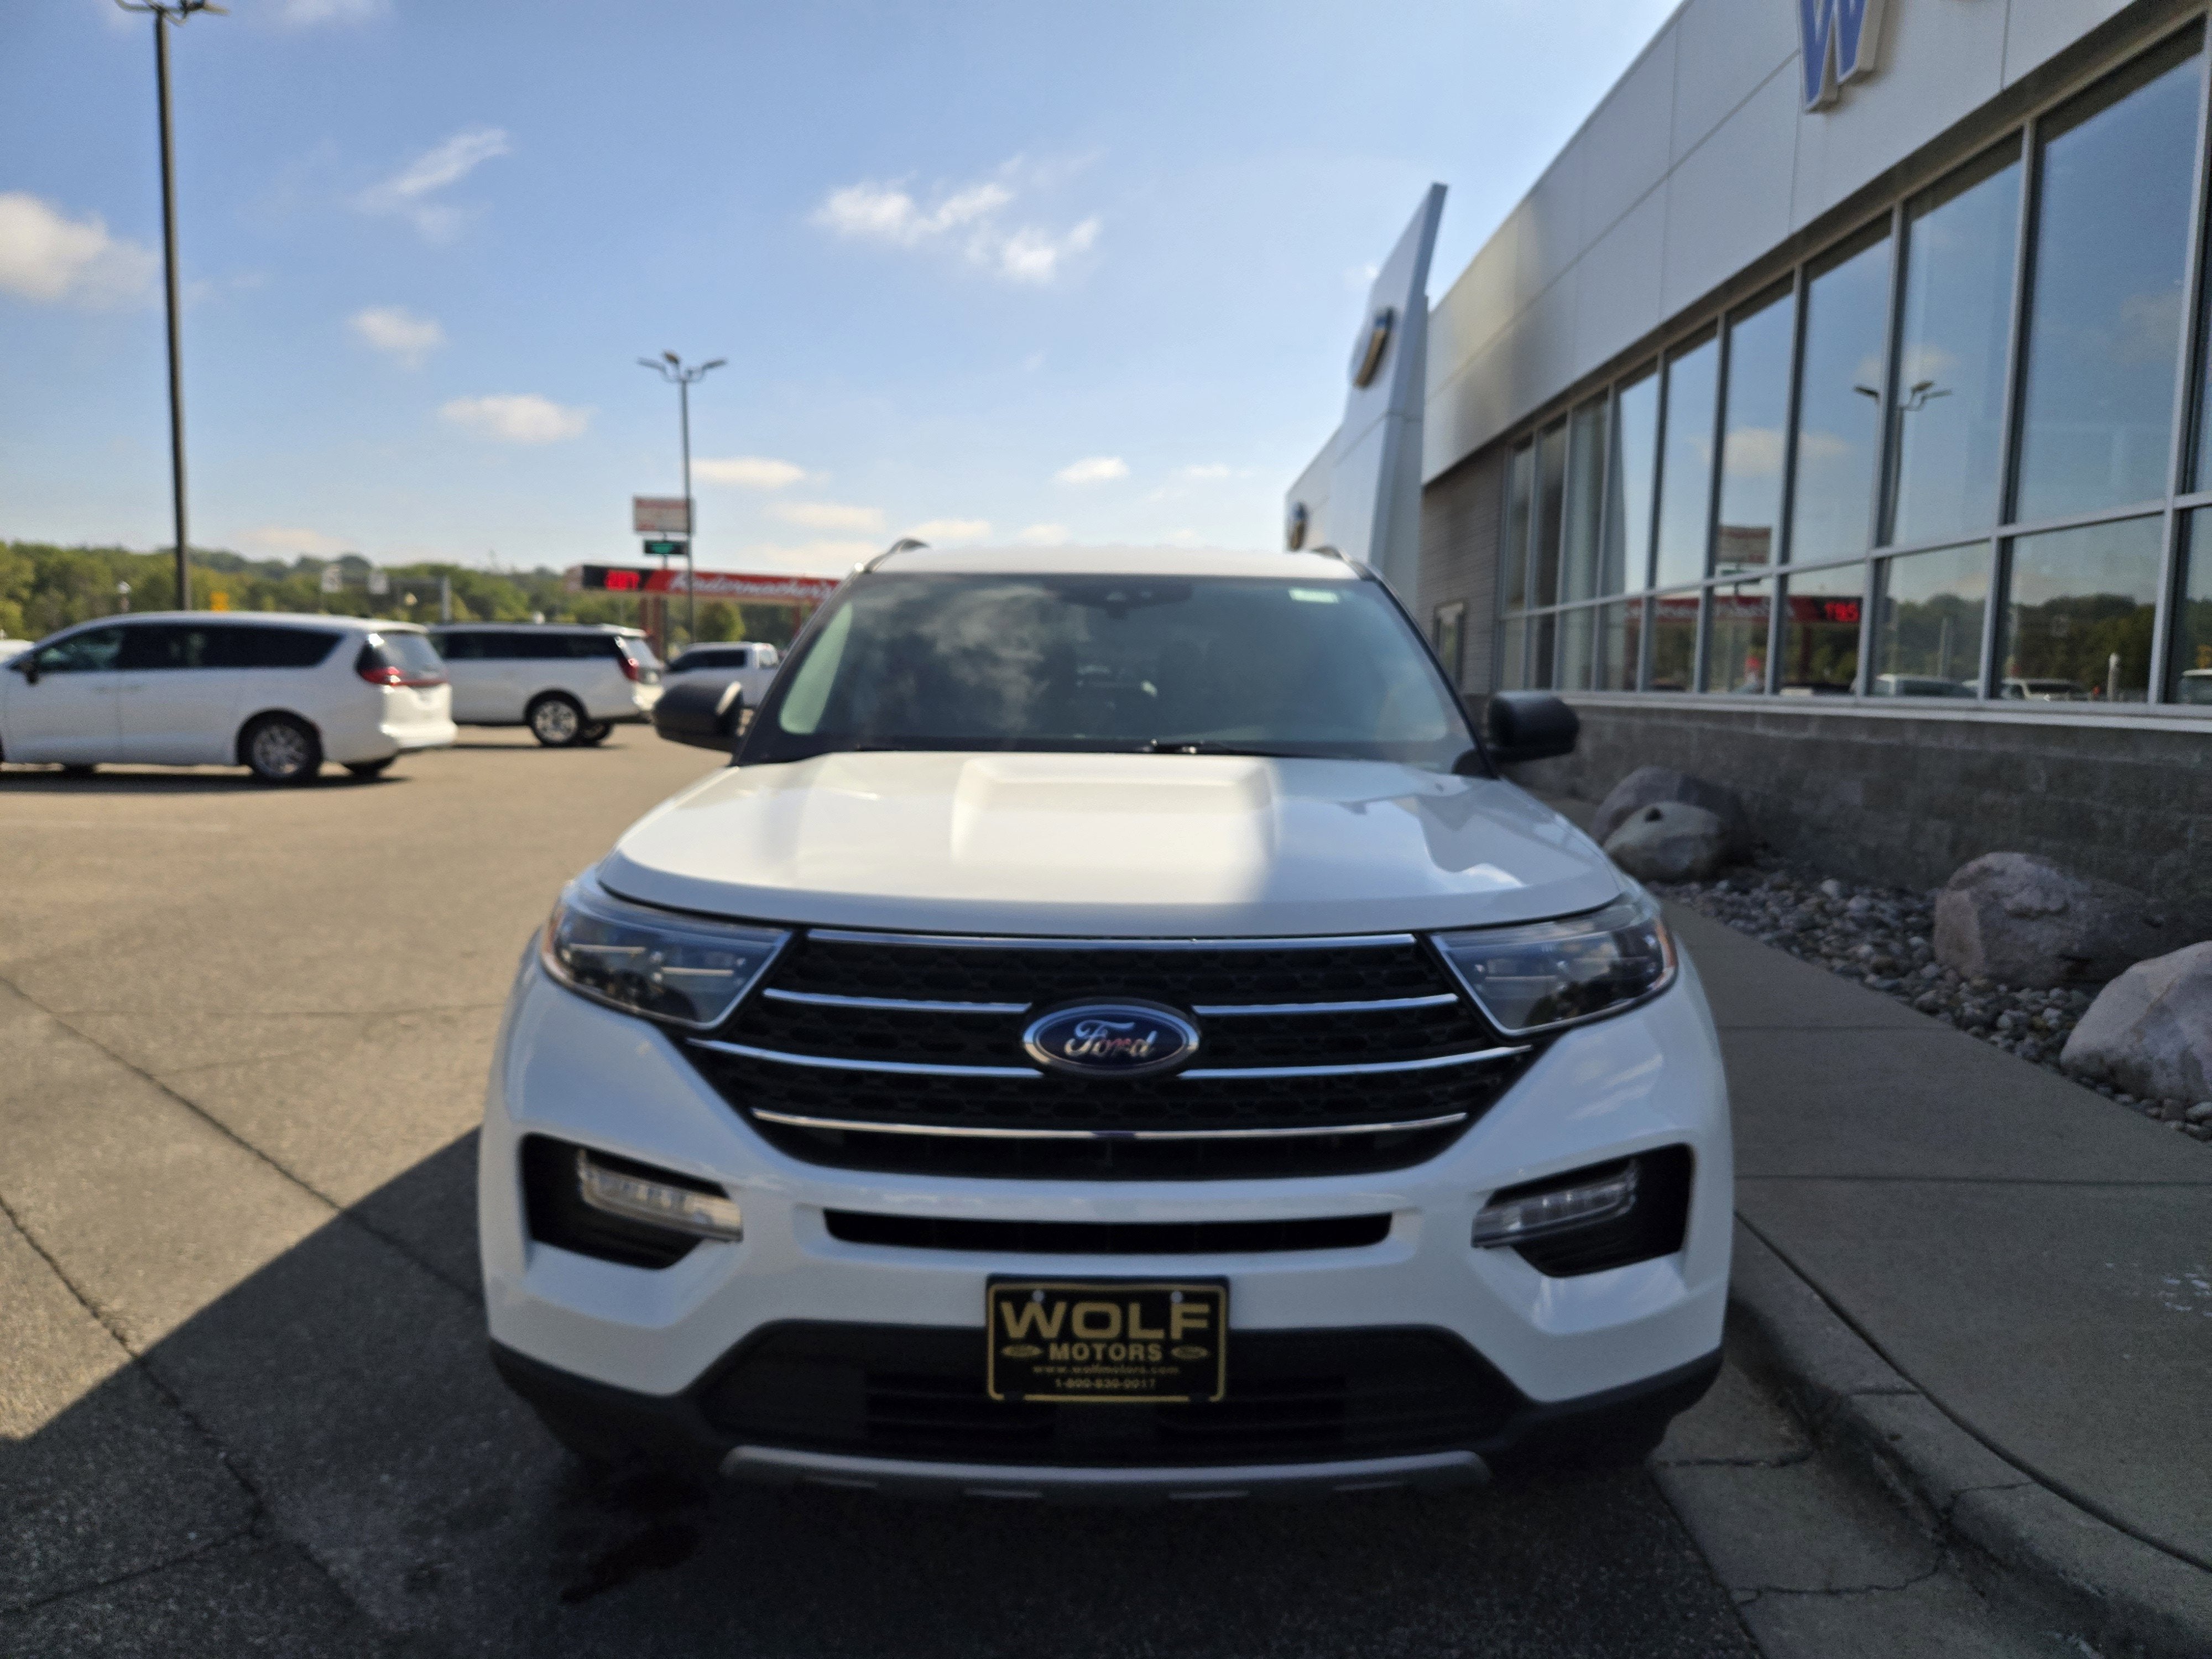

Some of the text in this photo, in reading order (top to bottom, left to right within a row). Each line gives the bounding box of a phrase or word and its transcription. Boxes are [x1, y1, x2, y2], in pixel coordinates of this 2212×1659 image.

[1064, 1019, 1158, 1058] Ford
[1000, 1301, 1210, 1340] WOLF
[1049, 1342, 1162, 1361] MOTORS
